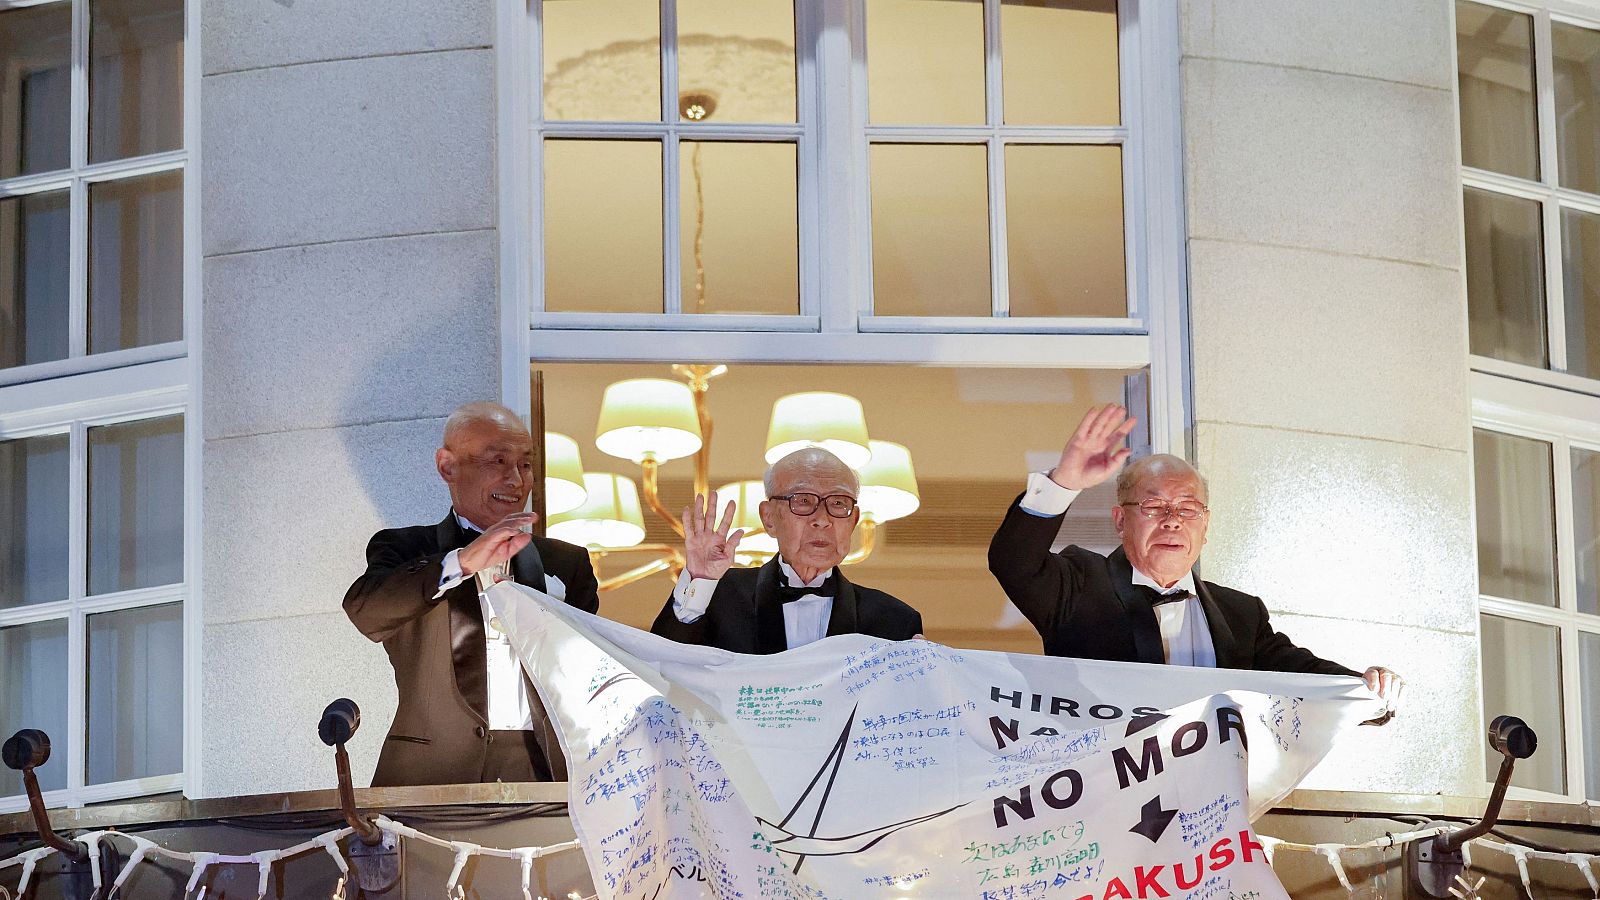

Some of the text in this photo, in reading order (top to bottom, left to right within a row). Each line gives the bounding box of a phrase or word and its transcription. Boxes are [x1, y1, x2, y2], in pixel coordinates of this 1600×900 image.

[993, 768, 1084, 829] NO
[1112, 706, 1249, 790] MOR
[1075, 829, 1271, 900] AKUSH
